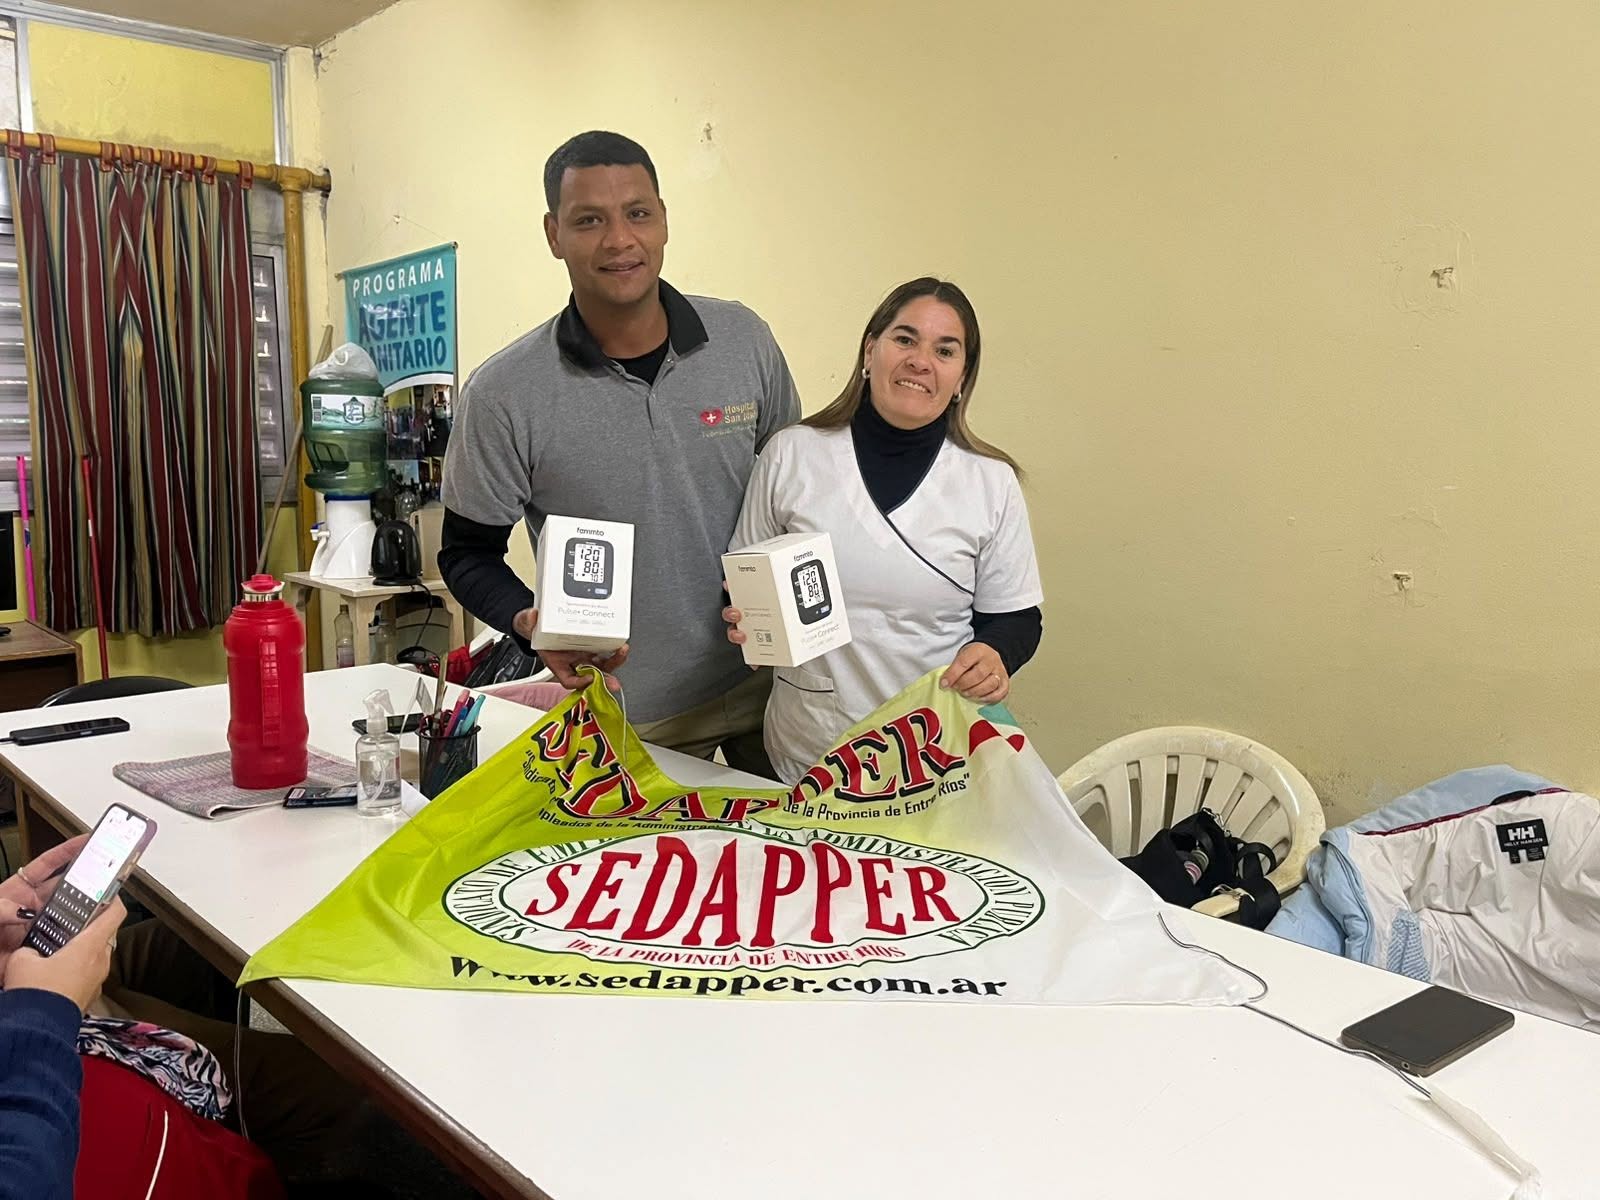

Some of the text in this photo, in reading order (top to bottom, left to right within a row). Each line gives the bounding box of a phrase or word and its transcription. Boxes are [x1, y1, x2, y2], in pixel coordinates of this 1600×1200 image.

[353, 258, 445, 297] PROGRAMA
[359, 290, 446, 343] AGENTE
[369, 335, 447, 372] ANITARIO
[580, 549, 600, 562] 120
[584, 561, 600, 574] 80
[802, 570, 817, 586] 120
[808, 583, 820, 598] 80
[802, 800, 814, 818] la
[817, 803, 880, 821] Provincia
[885, 805, 901, 818] de
[1507, 825, 1535, 841] HH
[480, 858, 533, 878] DE
[524, 835, 961, 948] SEDAPPER
[566, 939, 597, 953] DE
[599, 945, 623, 959] LA
[628, 949, 742, 966] PROVINCIA
[750, 951, 776, 967] DE
[783, 949, 853, 965] ENTRE
